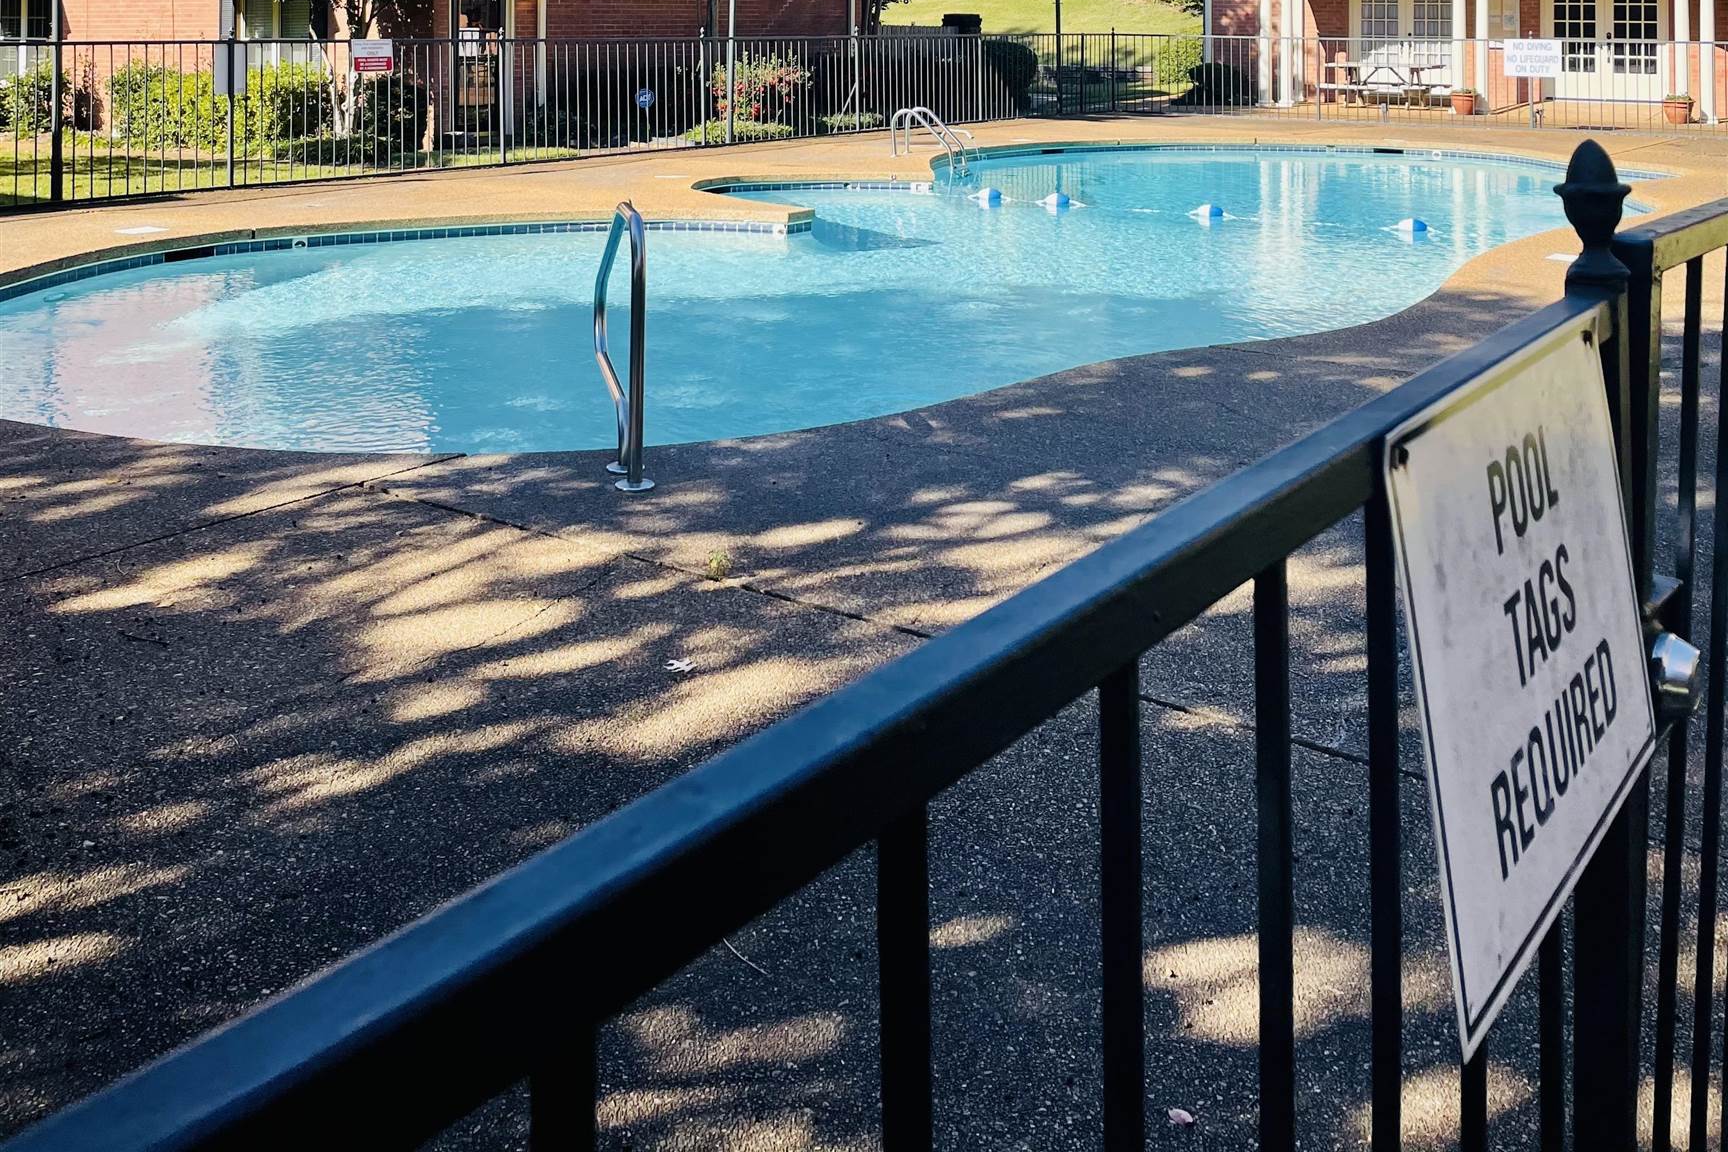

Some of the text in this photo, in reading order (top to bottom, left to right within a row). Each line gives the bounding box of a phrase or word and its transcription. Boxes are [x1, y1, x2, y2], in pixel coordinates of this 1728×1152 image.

[1506, 55, 1558, 64] NO LIFEGUARD
[1512, 41, 1552, 51] NO DIVING
[1515, 65, 1550, 73] ON DUTY
[1486, 425, 1559, 556] POOL
[1503, 544, 1576, 689] TAGS
[1490, 637, 1619, 882] REQUIRED
